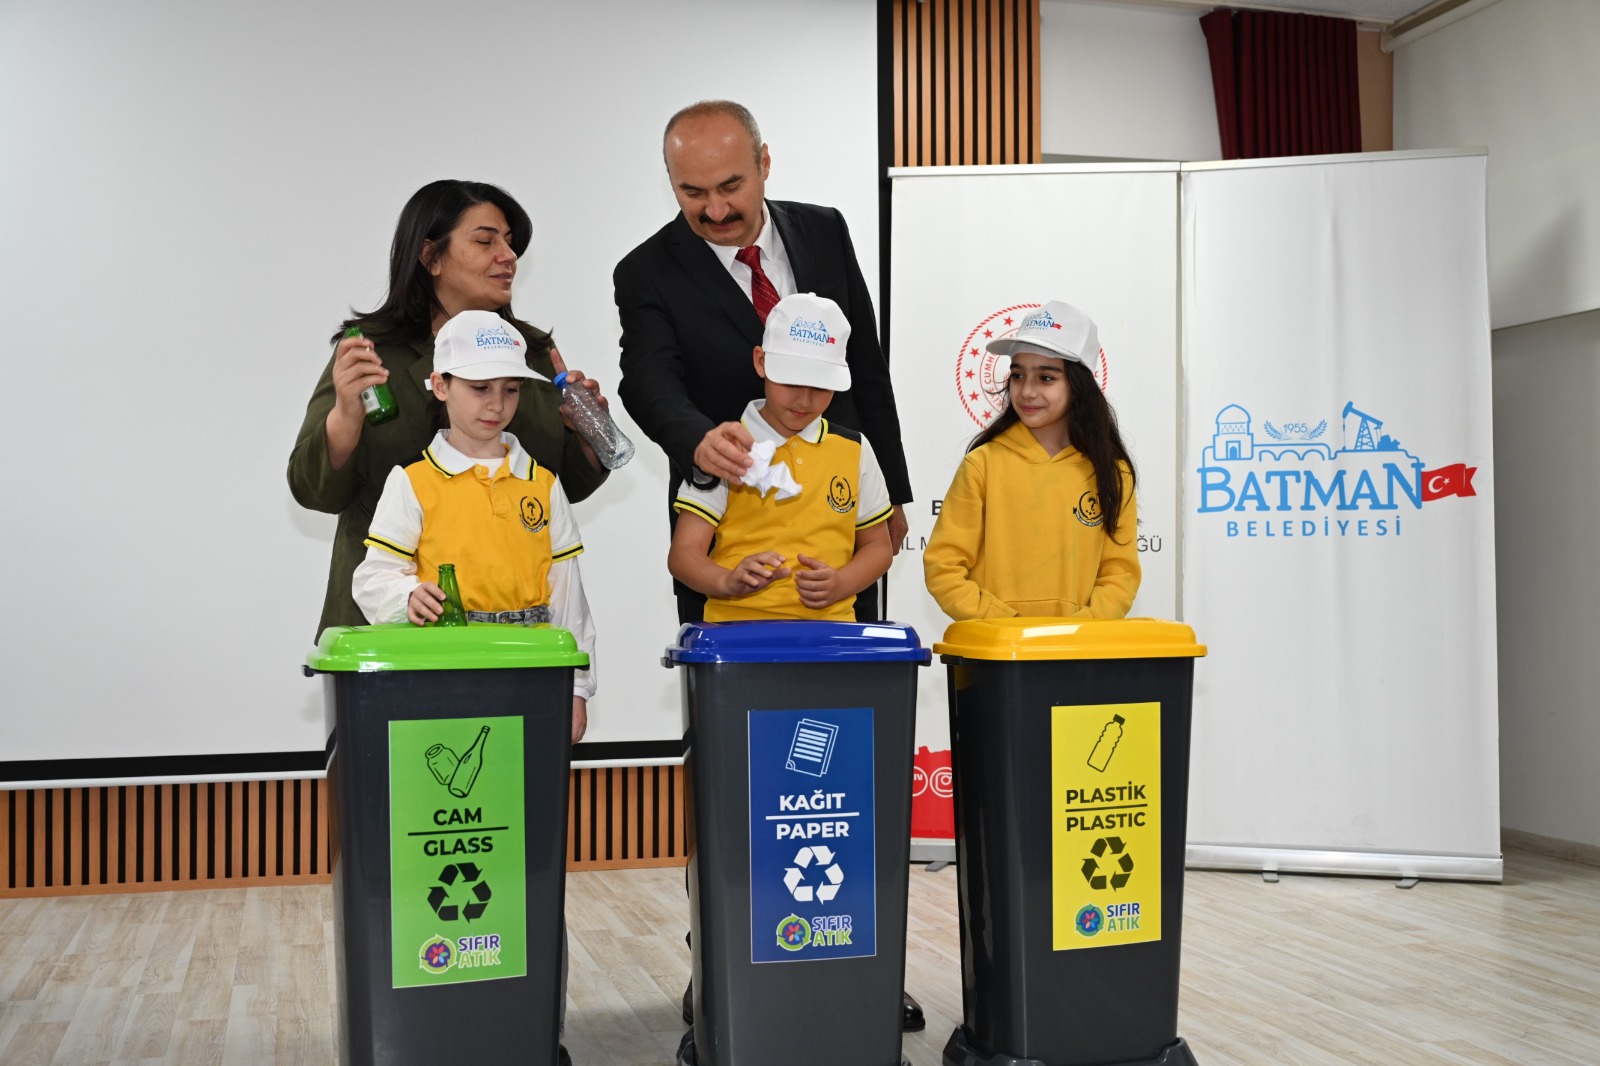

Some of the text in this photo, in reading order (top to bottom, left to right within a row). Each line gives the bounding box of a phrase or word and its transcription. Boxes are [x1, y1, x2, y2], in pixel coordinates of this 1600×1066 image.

[476, 336, 515, 347] BATMAN
[789, 326, 830, 344] BATMAN
[1282, 422, 1308, 434] 1955
[1197, 463, 1426, 513] BATMAN
[1226, 515, 1401, 537] BELEDİYESİ
[779, 789, 846, 811] KAĞIT
[1066, 781, 1147, 804] PLASTİK
[433, 807, 482, 826] CAM
[1066, 811, 1146, 832] PLASTIC
[776, 821, 850, 840] PAPER
[423, 836, 494, 857] GLASS
[1106, 902, 1140, 918] SIFIR
[812, 915, 852, 931] SIFIR
[1107, 916, 1140, 932] ATIK
[458, 934, 500, 952] SIFIR
[812, 929, 852, 947] ATIK
[458, 950, 501, 969] ATIK
